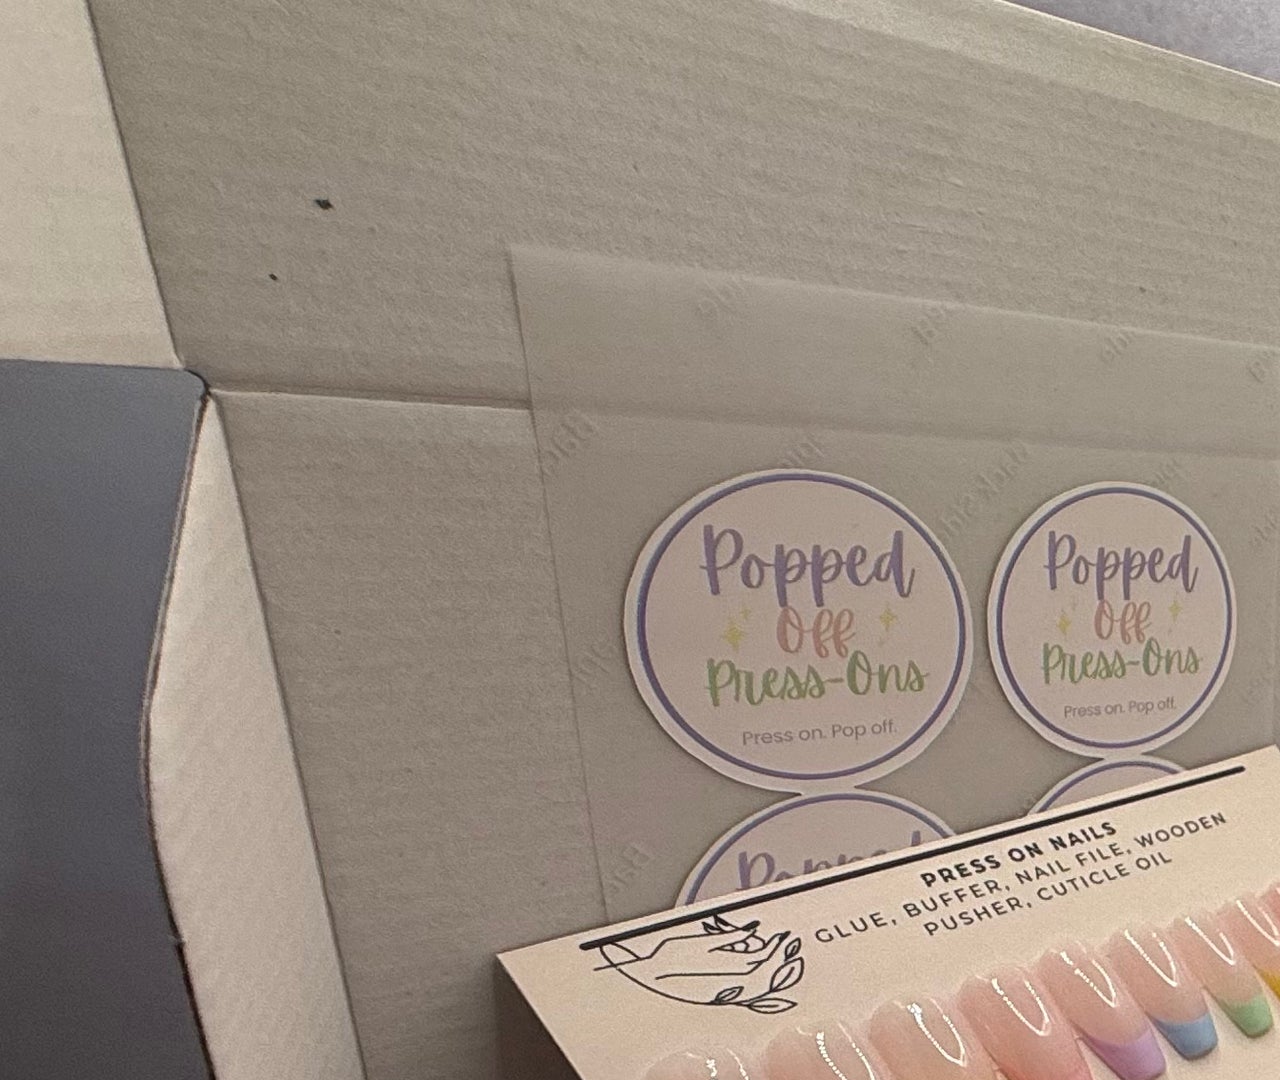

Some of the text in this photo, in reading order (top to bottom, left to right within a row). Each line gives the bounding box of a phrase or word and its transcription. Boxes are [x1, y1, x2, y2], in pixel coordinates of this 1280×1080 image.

[700, 524, 916, 607] Popped
[1043, 530, 1199, 600] Popped
[777, 605, 856, 658] Off
[1094, 600, 1152, 645] Off
[704, 650, 931, 707] Press-Ons
[1041, 637, 1203, 684] Press-Ons
[742, 719, 898, 746] Press on. Pop off.
[1064, 697, 1177, 718] Press on. Pop off.
[815, 812, 1227, 943] GLUE, BUFFER, NAIL FILE, WOODEN
[920, 854, 1001, 888] PRESS
[1007, 842, 1044, 863] ON
[1049, 821, 1117, 851] NAILS
[923, 851, 1172, 936] PUSHER, CUTICLE OIL
